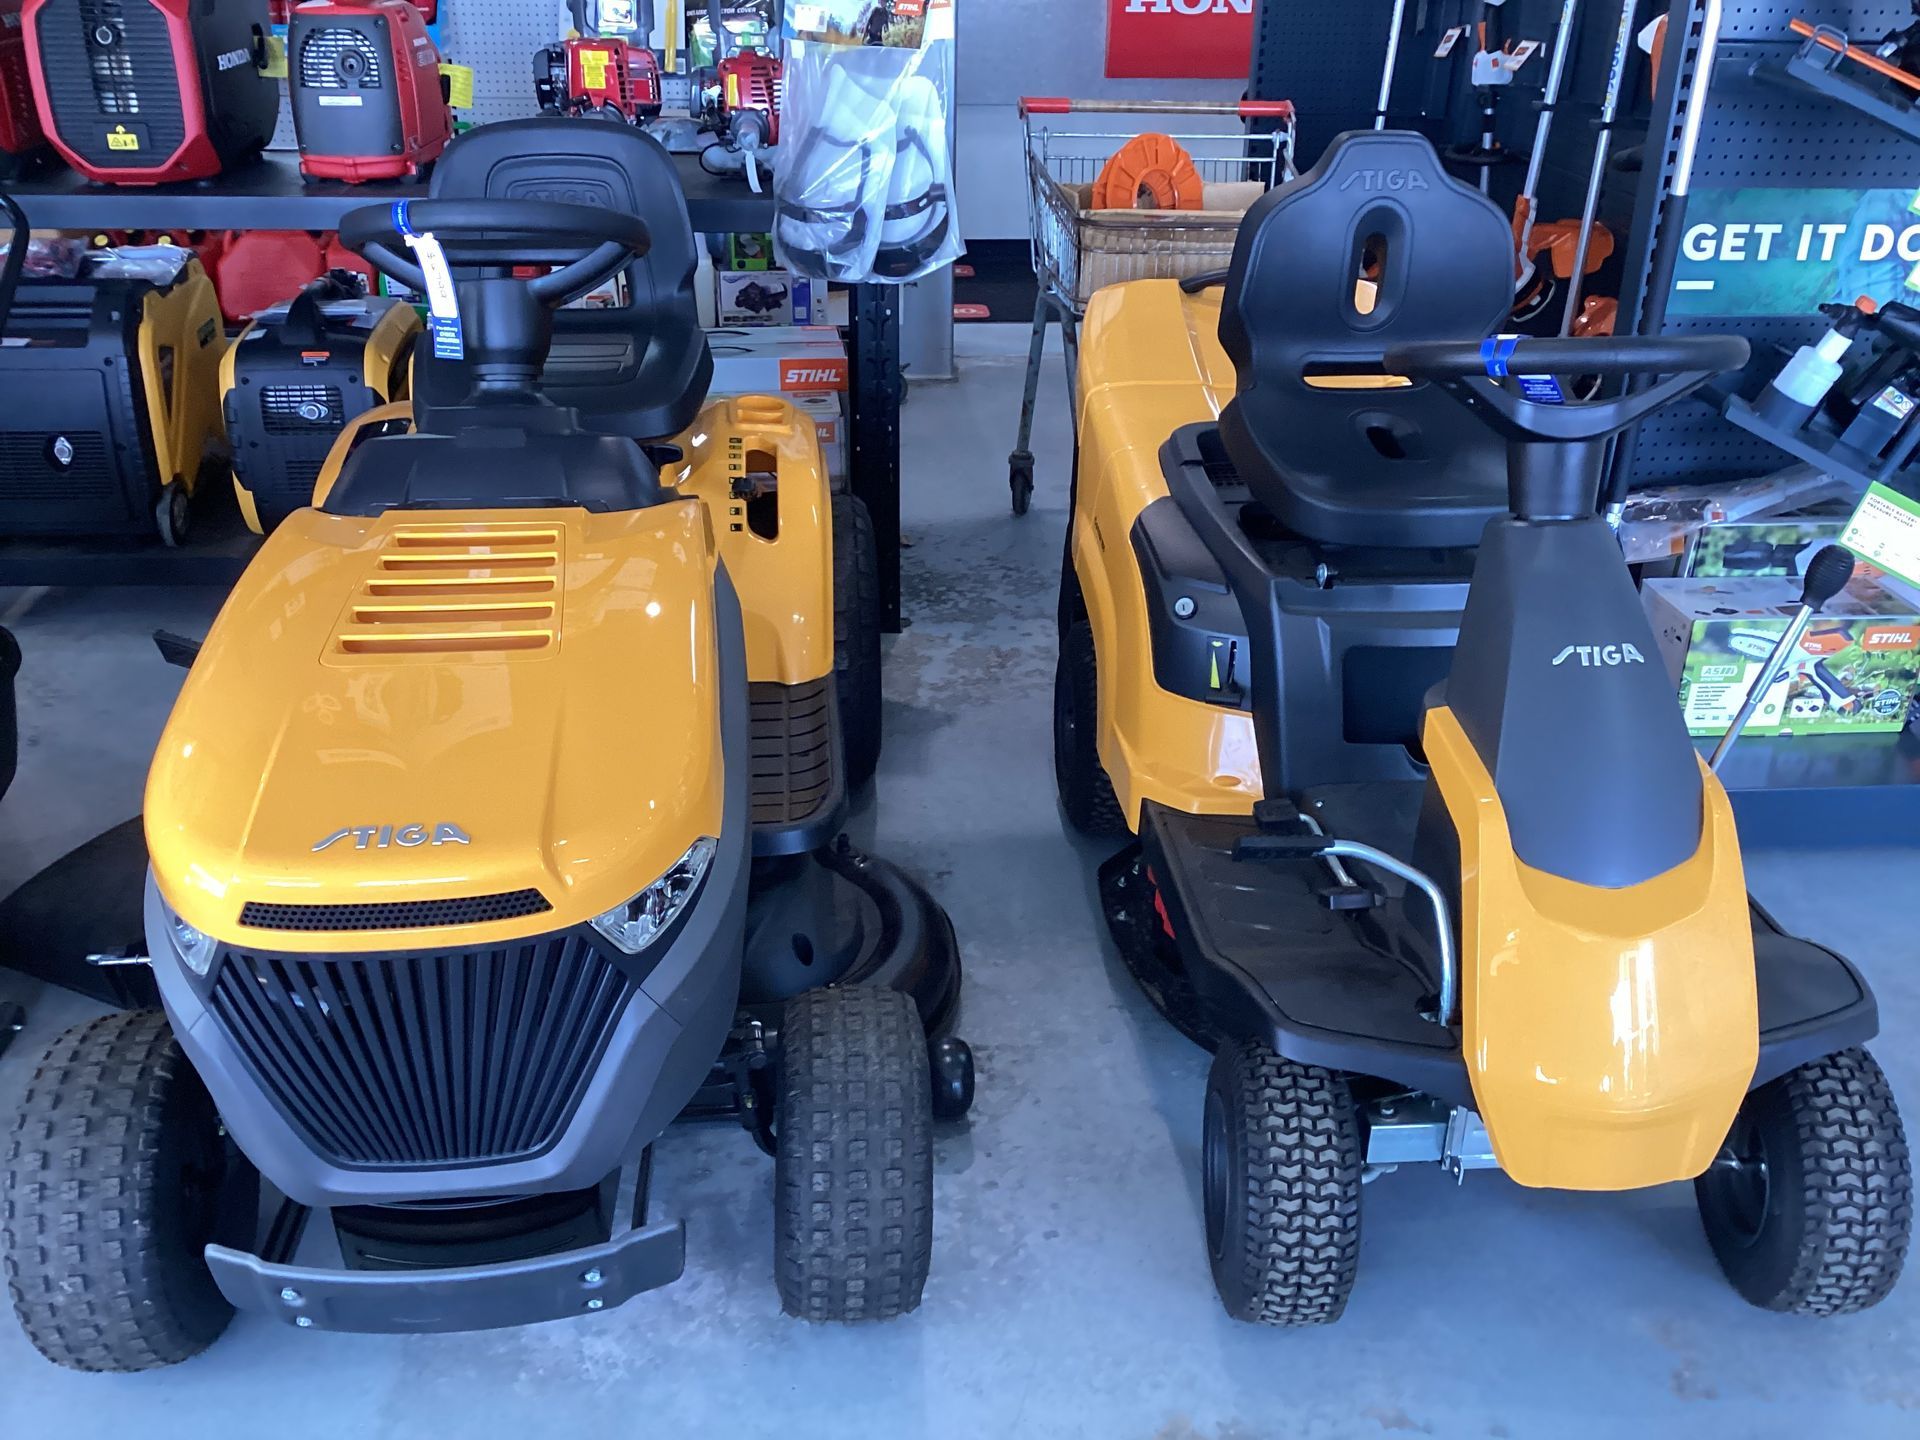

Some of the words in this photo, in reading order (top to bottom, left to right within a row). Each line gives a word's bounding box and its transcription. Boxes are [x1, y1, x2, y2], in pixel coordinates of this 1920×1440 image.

[1340, 168, 1429, 192] STIGA
[1682, 223, 1783, 261] GET
[1796, 224, 1847, 261] IT
[785, 368, 840, 383] STIHL
[1868, 633, 1912, 644] STIHL
[1552, 643, 1645, 666] STIGA
[1874, 696, 1900, 707] STIHL
[312, 822, 470, 852] STIGA
